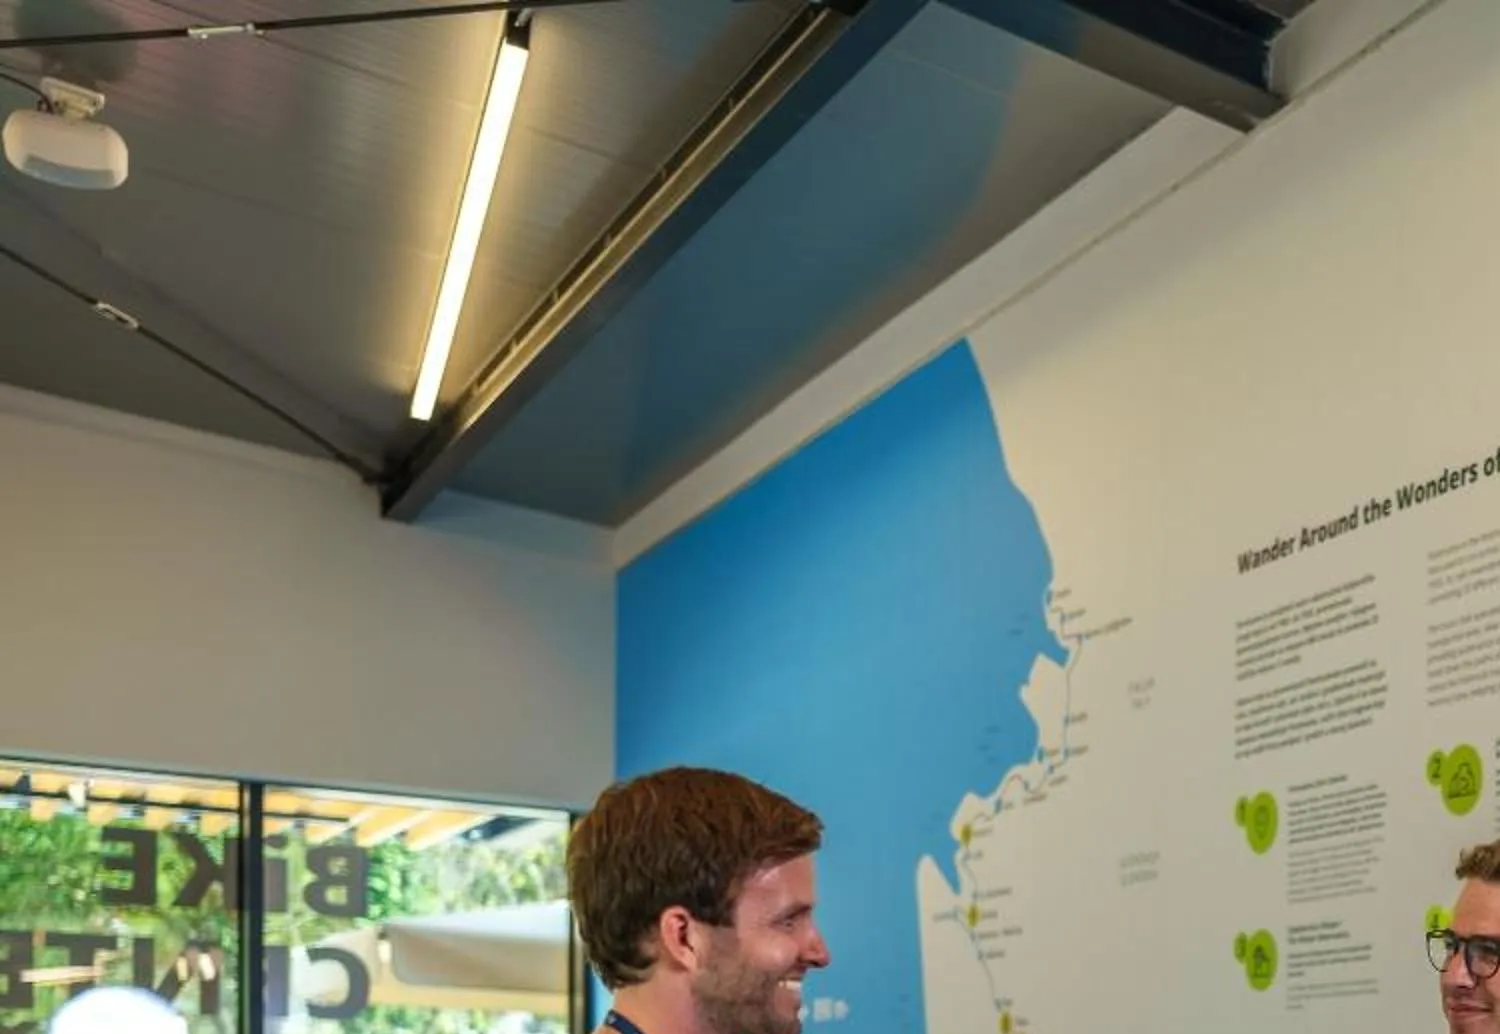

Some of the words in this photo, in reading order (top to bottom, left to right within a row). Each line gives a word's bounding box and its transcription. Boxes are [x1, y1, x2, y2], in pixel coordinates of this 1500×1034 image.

[1237, 537, 1296, 575] Wander
[1299, 505, 1359, 552] Around
[1363, 497, 1392, 525] the
[1396, 464, 1479, 512] Wonders
